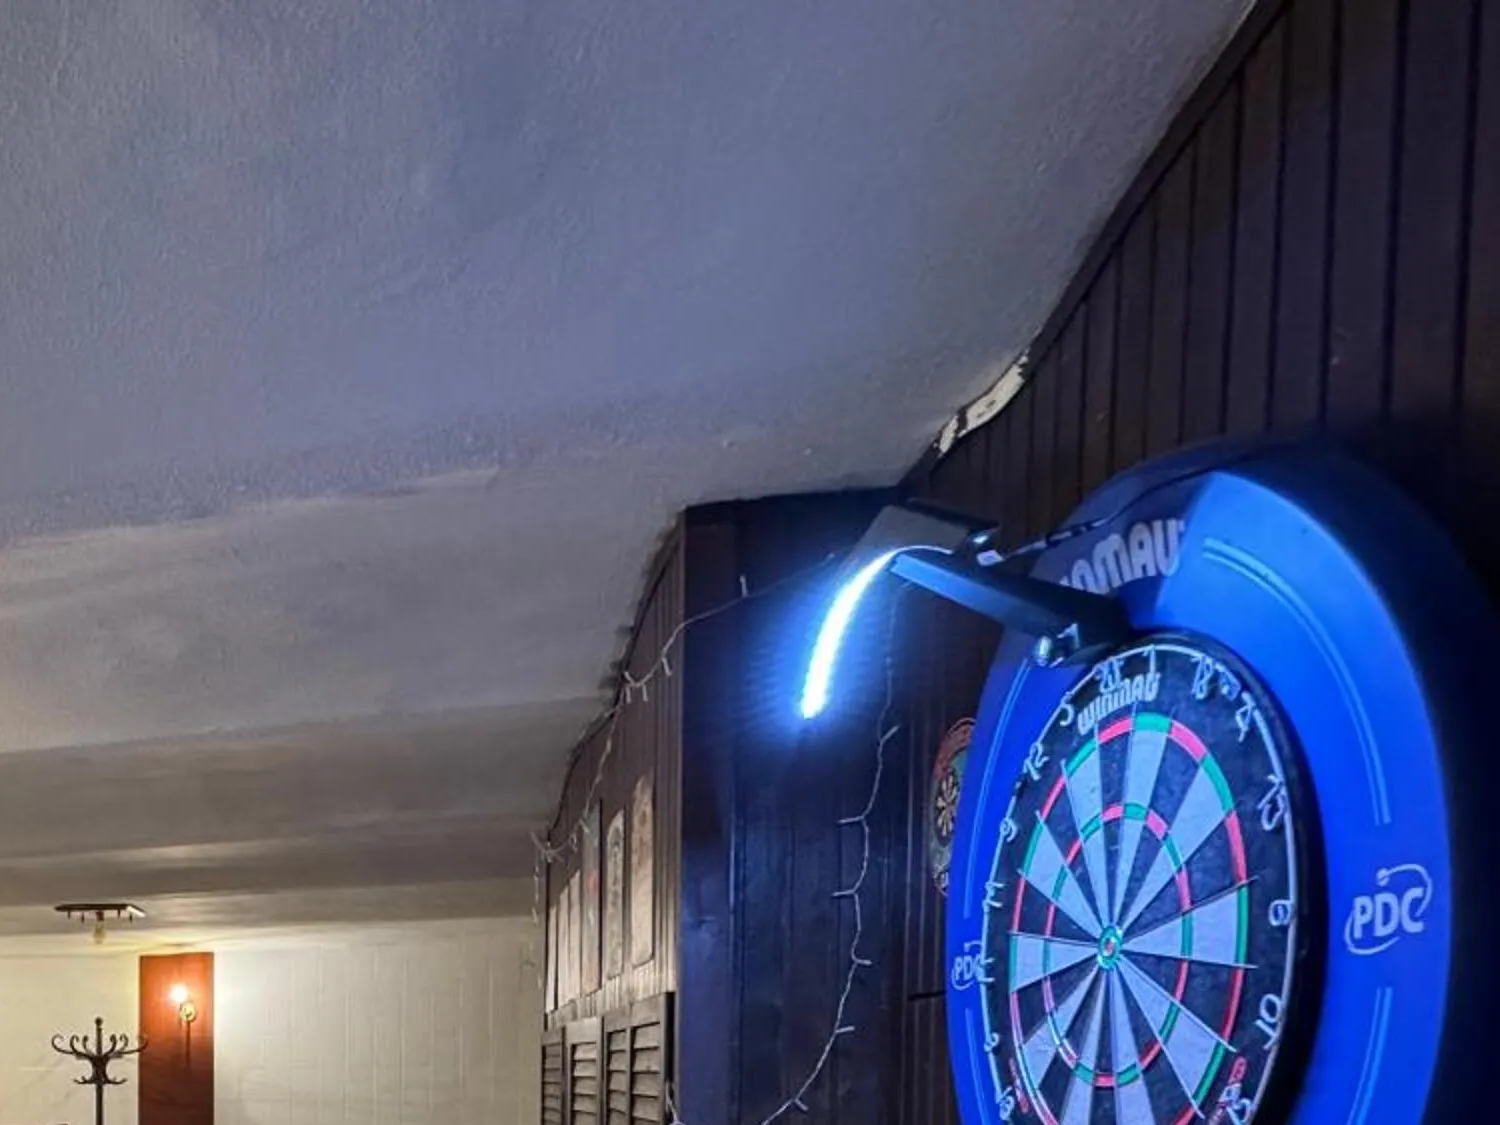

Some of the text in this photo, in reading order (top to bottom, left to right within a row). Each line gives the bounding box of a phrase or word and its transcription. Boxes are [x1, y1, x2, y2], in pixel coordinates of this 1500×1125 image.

[1059, 519, 1180, 595] NMAU
[1077, 672, 1160, 736] WINMAU
[1354, 887, 1425, 940] PDC
[1254, 993, 1283, 1050] 10
